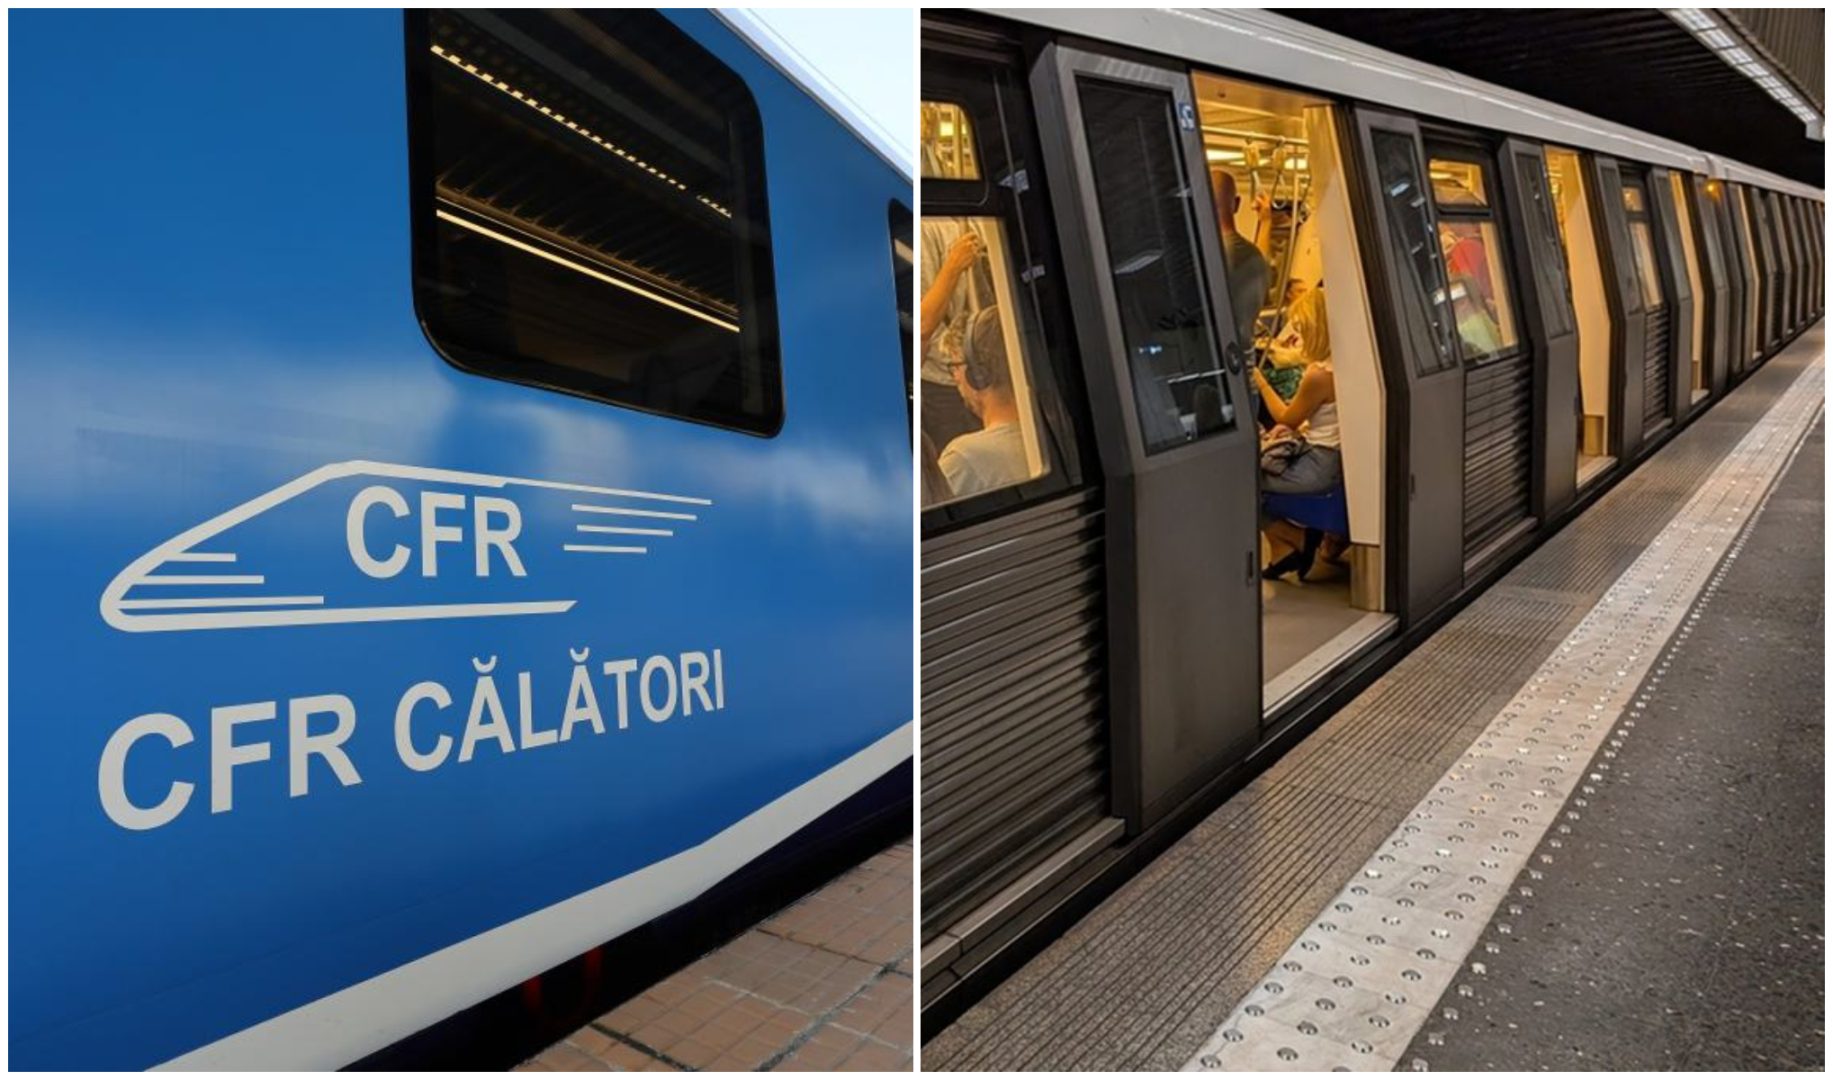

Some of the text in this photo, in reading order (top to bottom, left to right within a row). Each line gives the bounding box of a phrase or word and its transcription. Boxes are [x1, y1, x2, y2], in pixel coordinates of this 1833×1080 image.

[346, 486, 528, 578] CFR
[98, 647, 725, 830] CFR CĂLĂTORI
